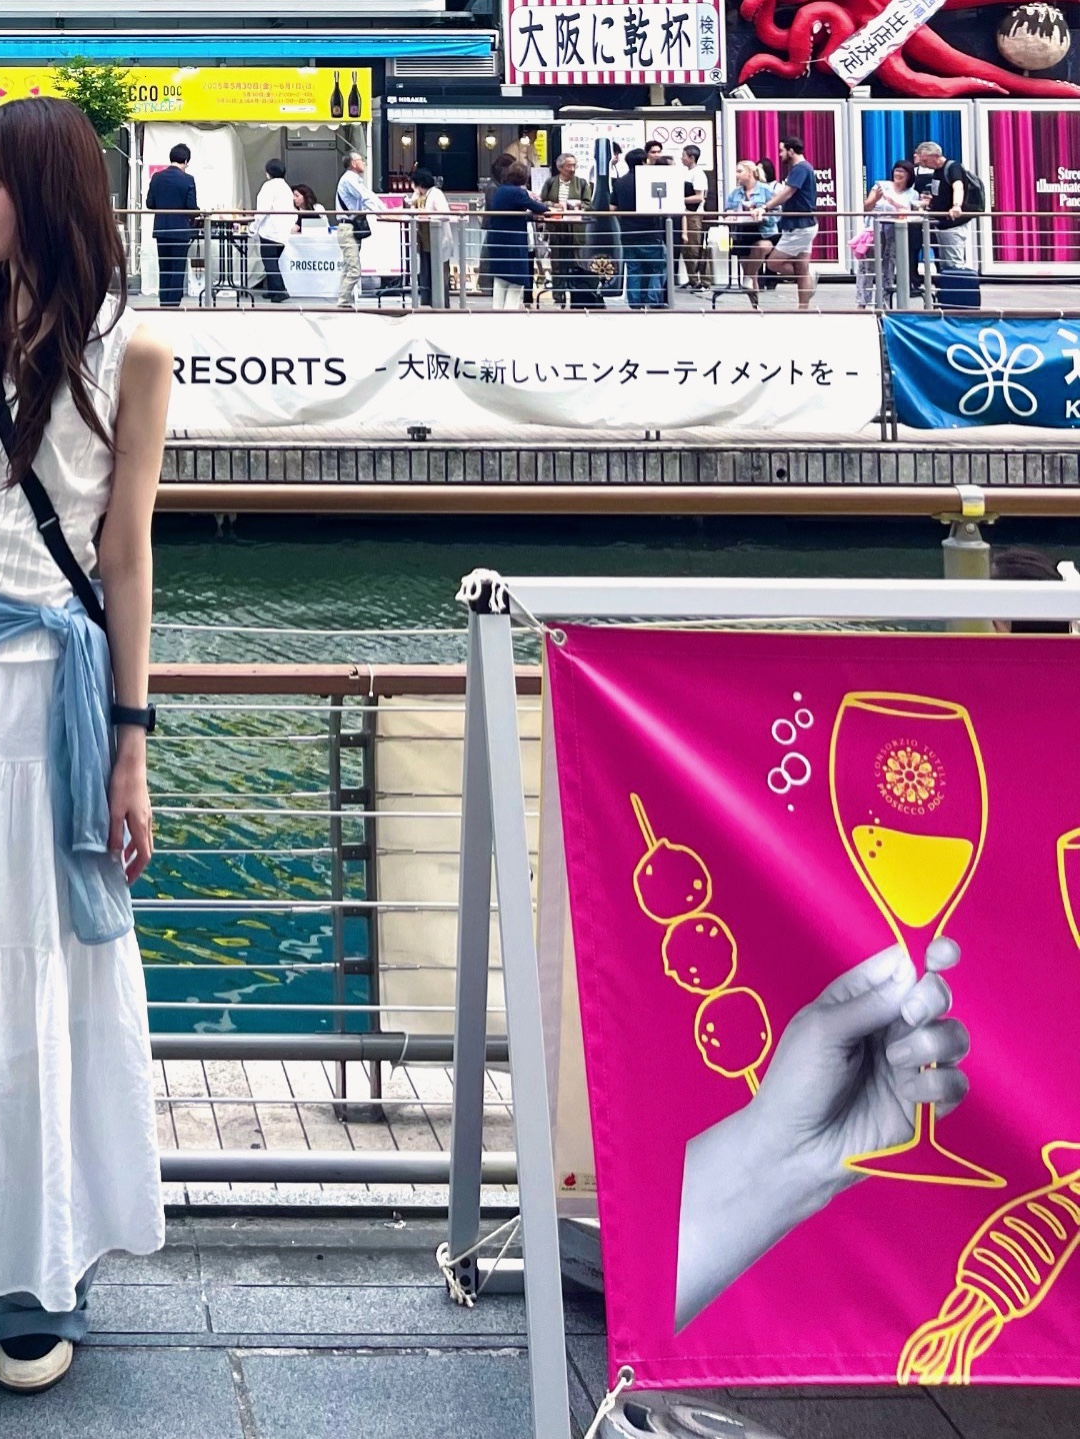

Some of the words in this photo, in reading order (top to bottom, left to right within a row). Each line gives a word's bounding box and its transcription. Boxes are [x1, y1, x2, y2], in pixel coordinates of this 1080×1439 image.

[519, 7, 691, 69] 大阪に乾杯
[700, 15, 714, 55] 検索
[839, 11, 909, 74] 出店決定
[290, 260, 335, 271] PROSECCO
[874, 738, 918, 778] CONSORZIO
[923, 745, 947, 787] TUTELA
[876, 783, 926, 816] PROSECCO
[927, 791, 945, 812] DOC
